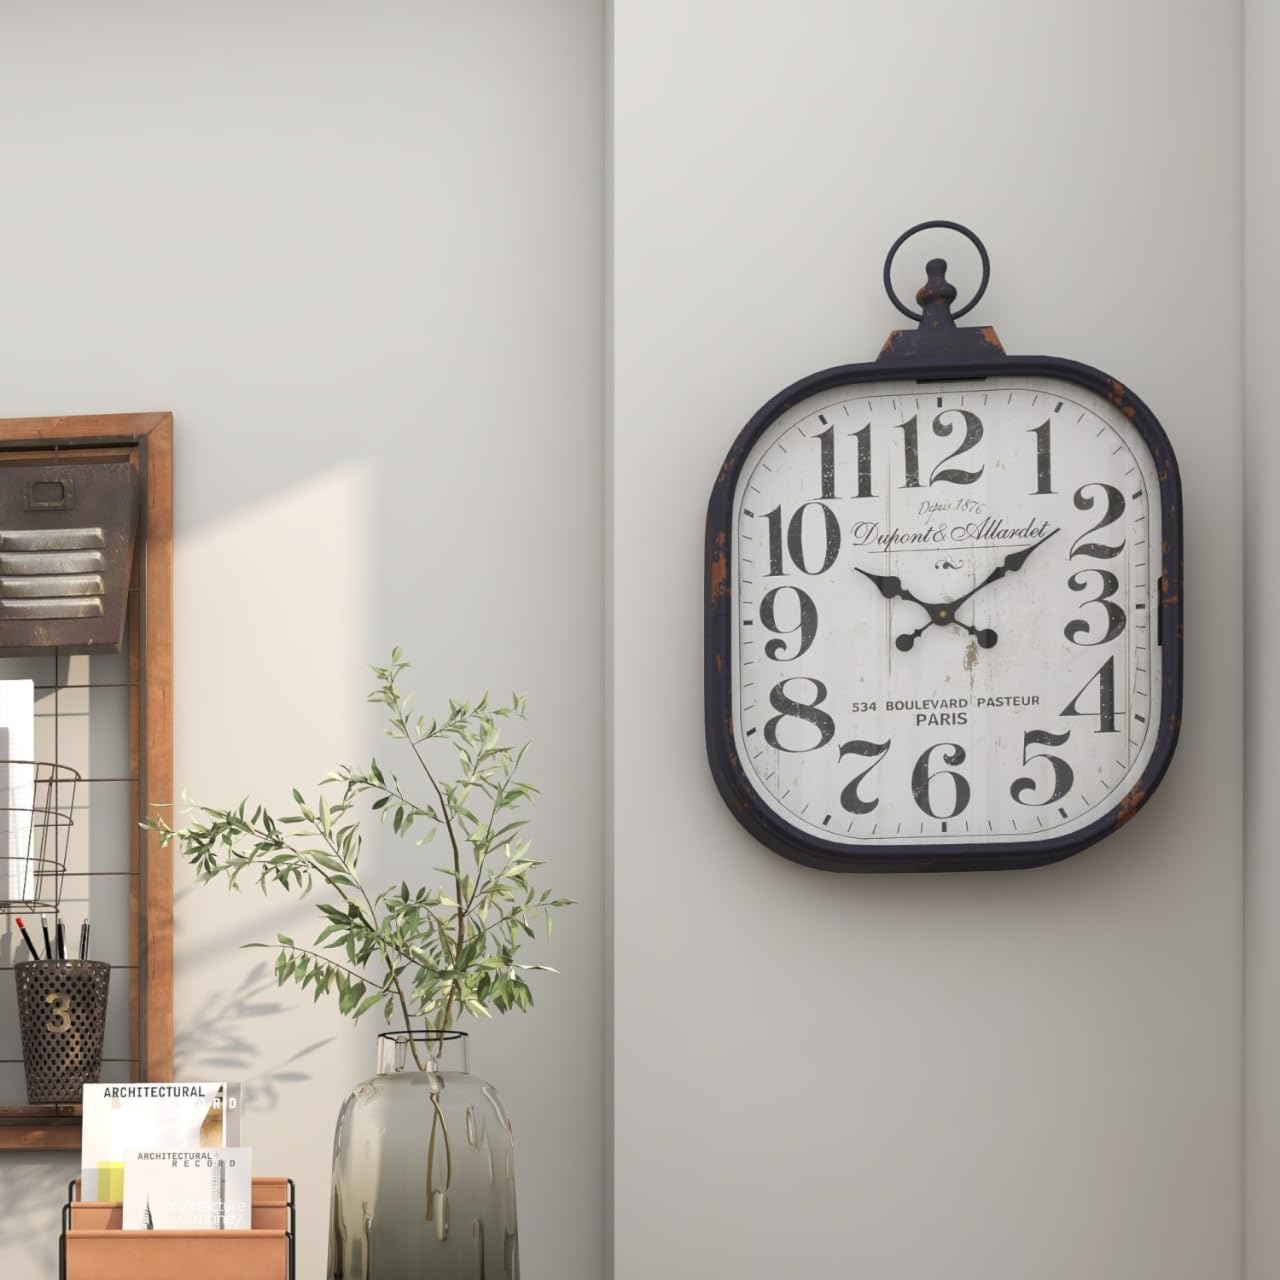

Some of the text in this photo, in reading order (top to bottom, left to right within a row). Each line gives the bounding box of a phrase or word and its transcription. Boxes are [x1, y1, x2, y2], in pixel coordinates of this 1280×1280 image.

[810, 422, 880, 501] 11
[893, 408, 985, 489] 12
[1026, 417, 1060, 496] 1
[759, 501, 842, 578] 10
[851, 516, 1049, 552] Dupont & Allardet
[1069, 482, 1126, 561] 2
[759, 585, 819, 662] 9
[1064, 569, 1127, 647] 3
[763, 676, 836, 753] 8
[852, 696, 1040, 712] 534 BOULEVARD PASTEUR
[916, 712, 968, 726] PARIS
[1059, 654, 1126, 734] 4
[838, 737, 891, 815] 7
[911, 742, 971, 819] 6
[1010, 729, 1075, 807] 5
[45, 992, 72, 1034] 3
[103, 1086, 205, 1098] ARCHITECTURAL
[137, 1152, 213, 1160] ARCHITECTURAL
